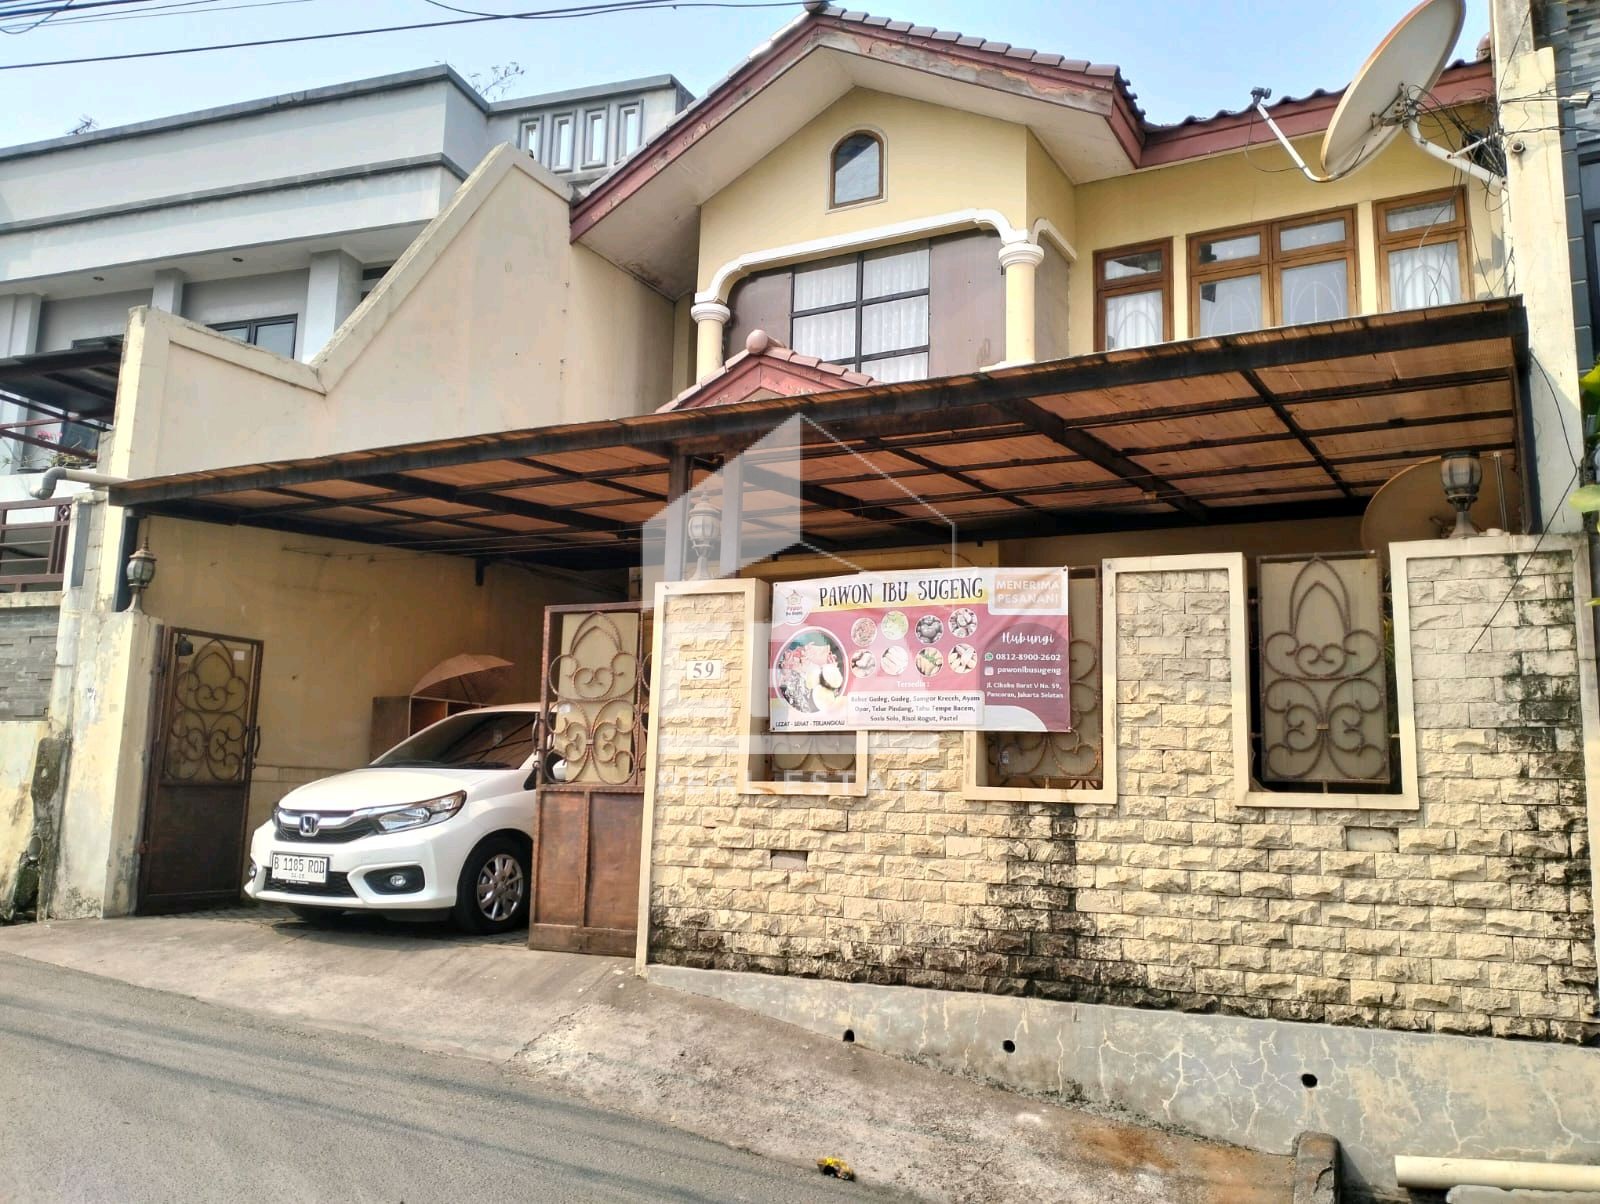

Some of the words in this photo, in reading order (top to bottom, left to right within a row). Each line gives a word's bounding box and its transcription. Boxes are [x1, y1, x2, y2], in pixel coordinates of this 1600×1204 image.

[996, 580, 1059, 590] MENERIMA
[820, 583, 873, 607] PAWON
[882, 581, 908, 602] IBU
[918, 577, 983, 600] SUGENG
[1001, 631, 1055, 645] Hubungi
[995, 652, 1061, 661] 0812-8900-2602
[692, 661, 714, 678] 59
[997, 665, 1061, 675] pawonibusugeng
[962, 695, 980, 703] Ayam
[273, 856, 280, 870] B
